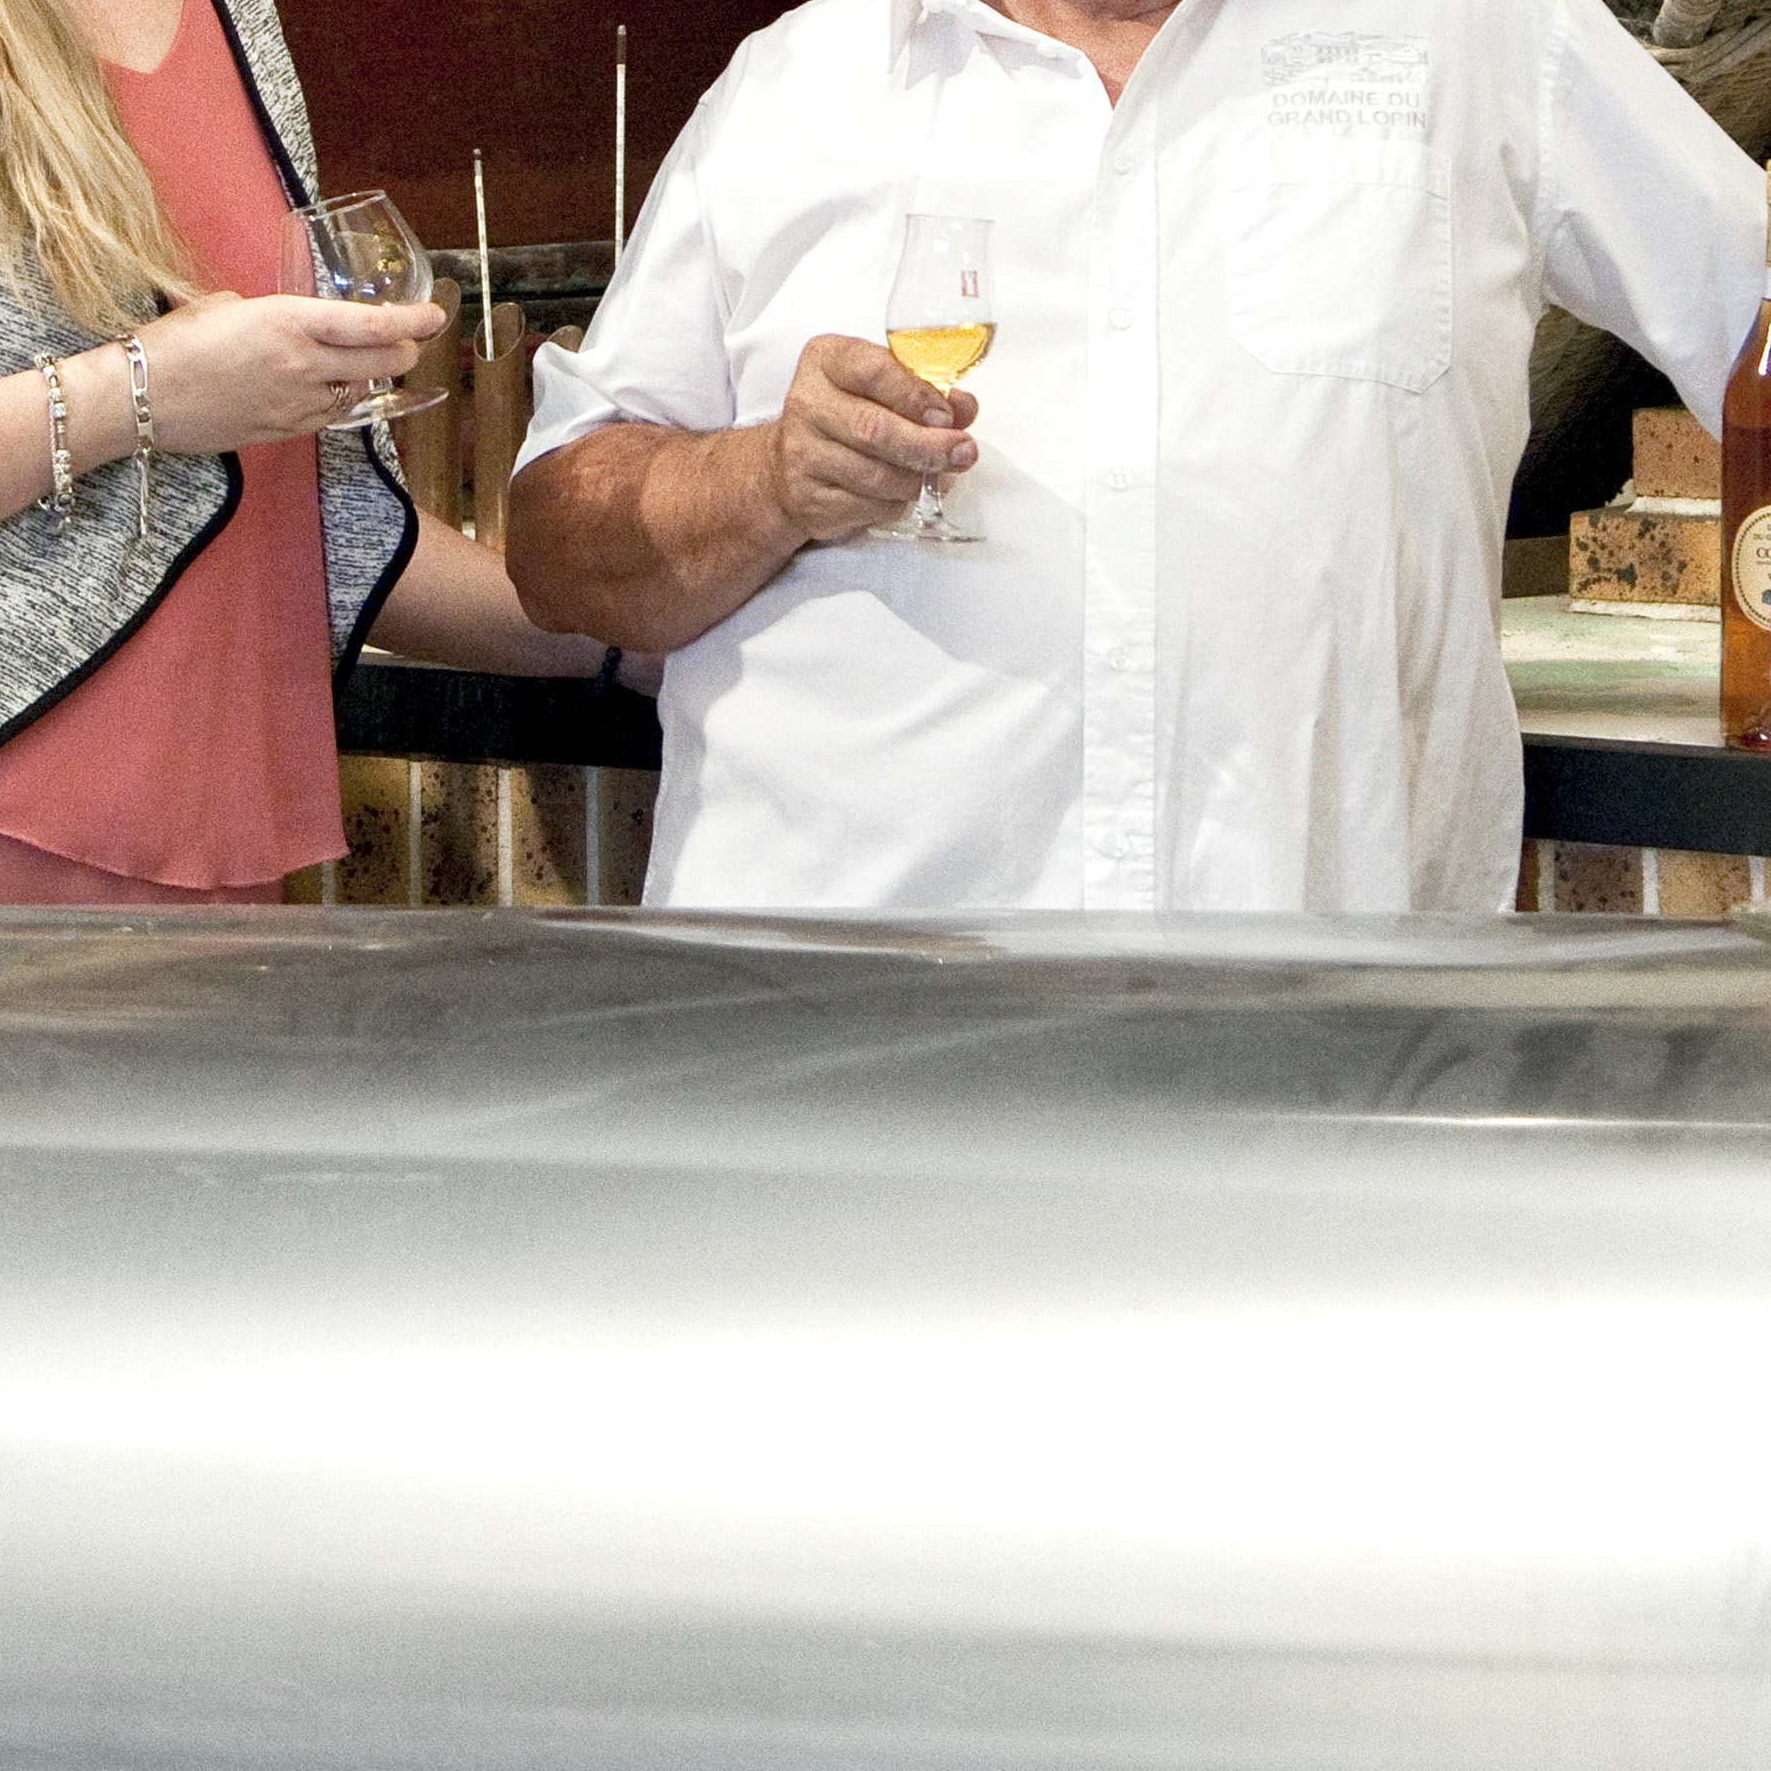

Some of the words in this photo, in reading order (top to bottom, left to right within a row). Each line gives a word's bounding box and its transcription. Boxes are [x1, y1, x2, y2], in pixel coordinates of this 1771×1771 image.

[1272, 89, 1379, 108] DOMAINE
[1388, 92, 1420, 109] DU
[1267, 108, 1351, 127] GRAND
[1356, 109, 1427, 129] LOPIN
